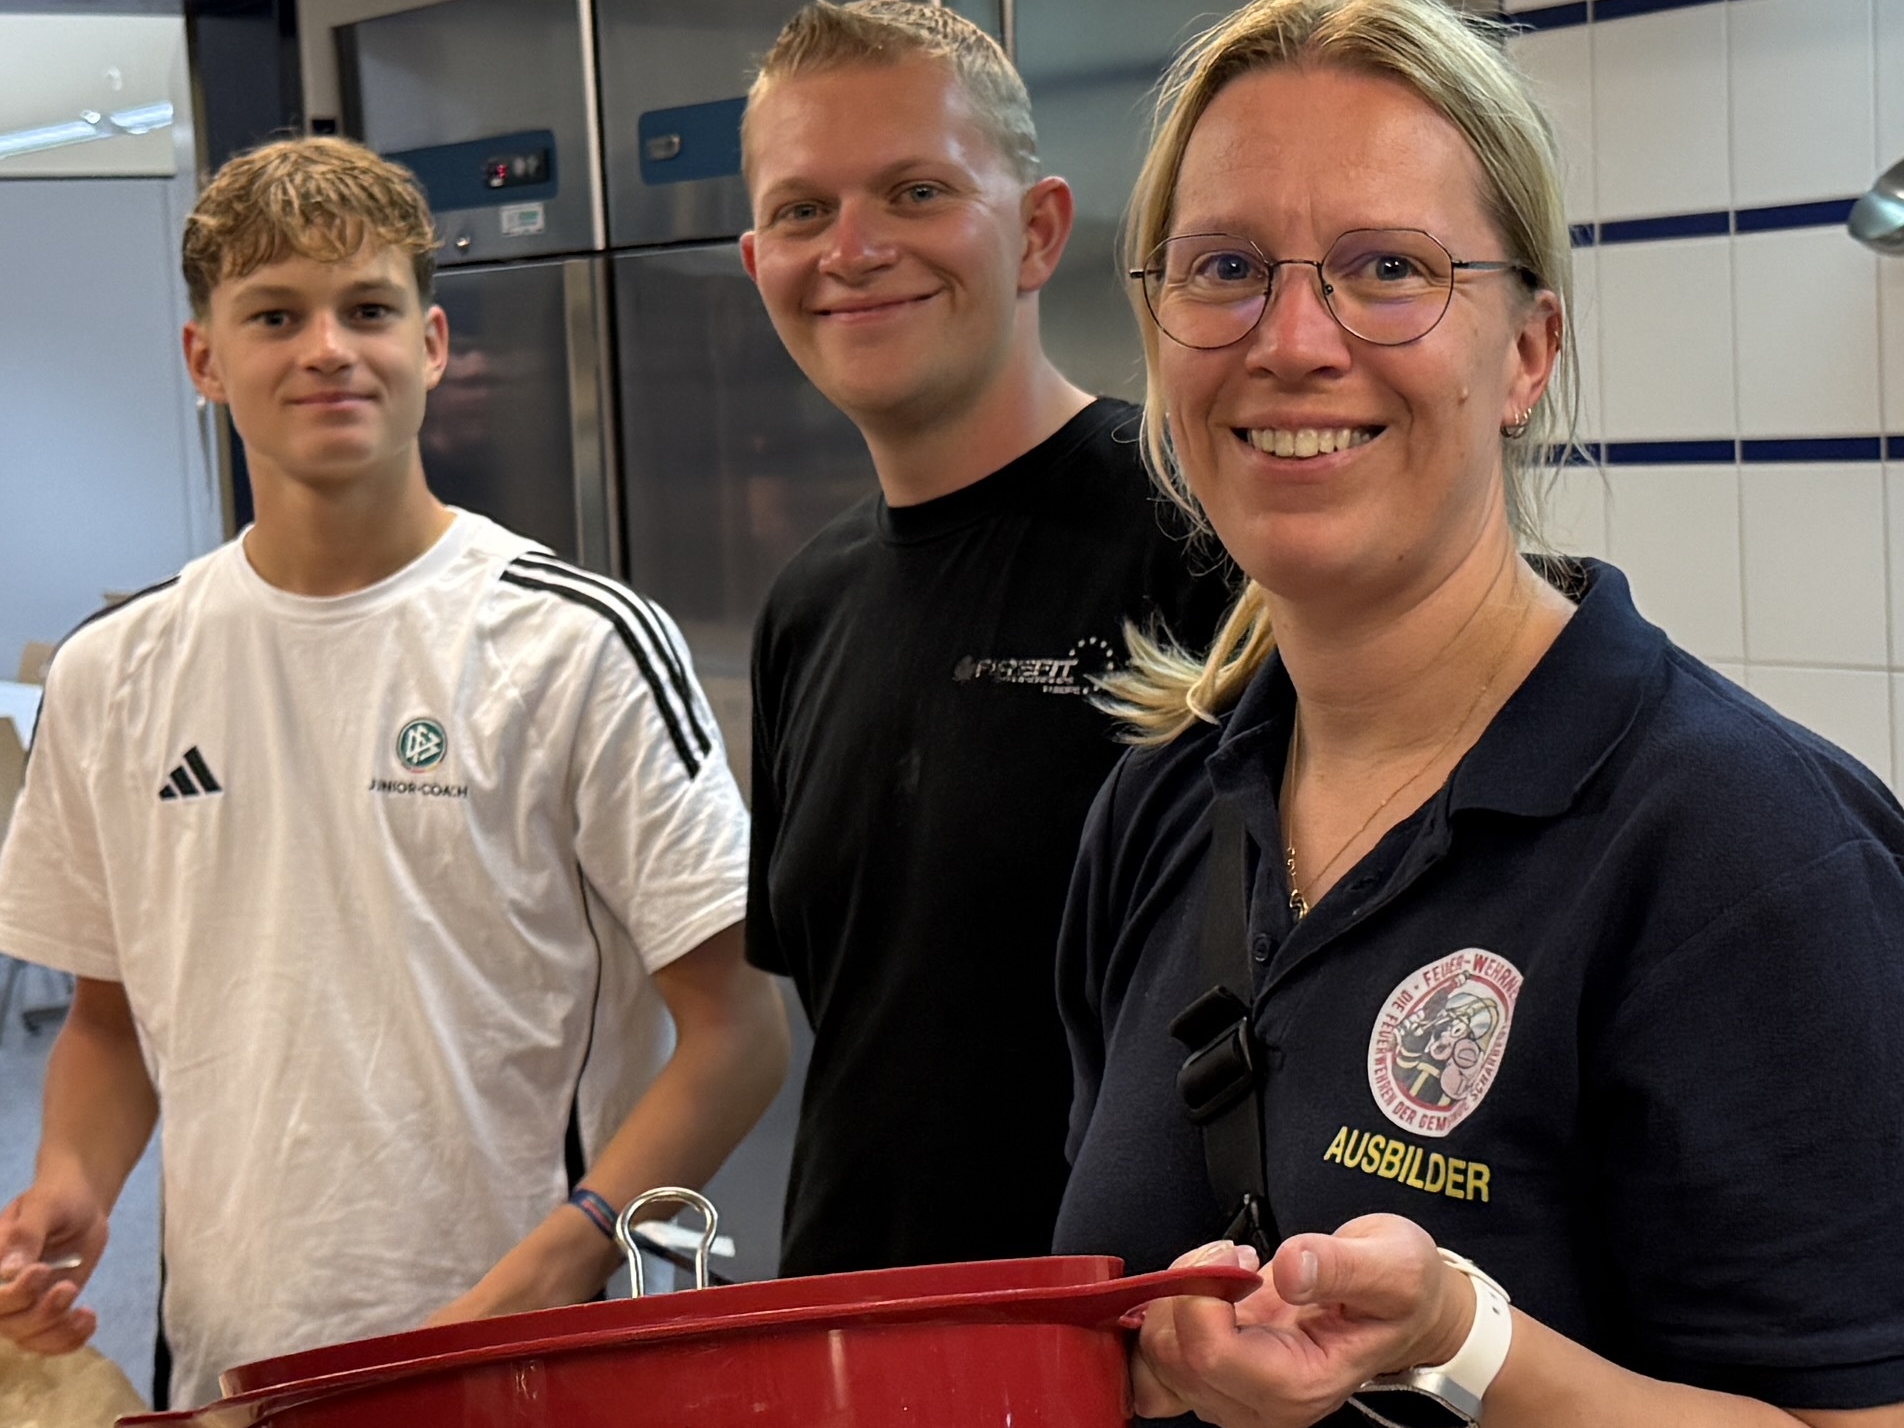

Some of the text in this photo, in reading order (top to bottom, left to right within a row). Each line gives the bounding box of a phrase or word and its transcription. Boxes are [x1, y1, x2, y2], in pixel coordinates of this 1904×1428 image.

[1391, 989, 1414, 1013] DIE
[1392, 1101, 1417, 1123] DER
[1323, 1125, 1492, 1203] AUSBILDER
